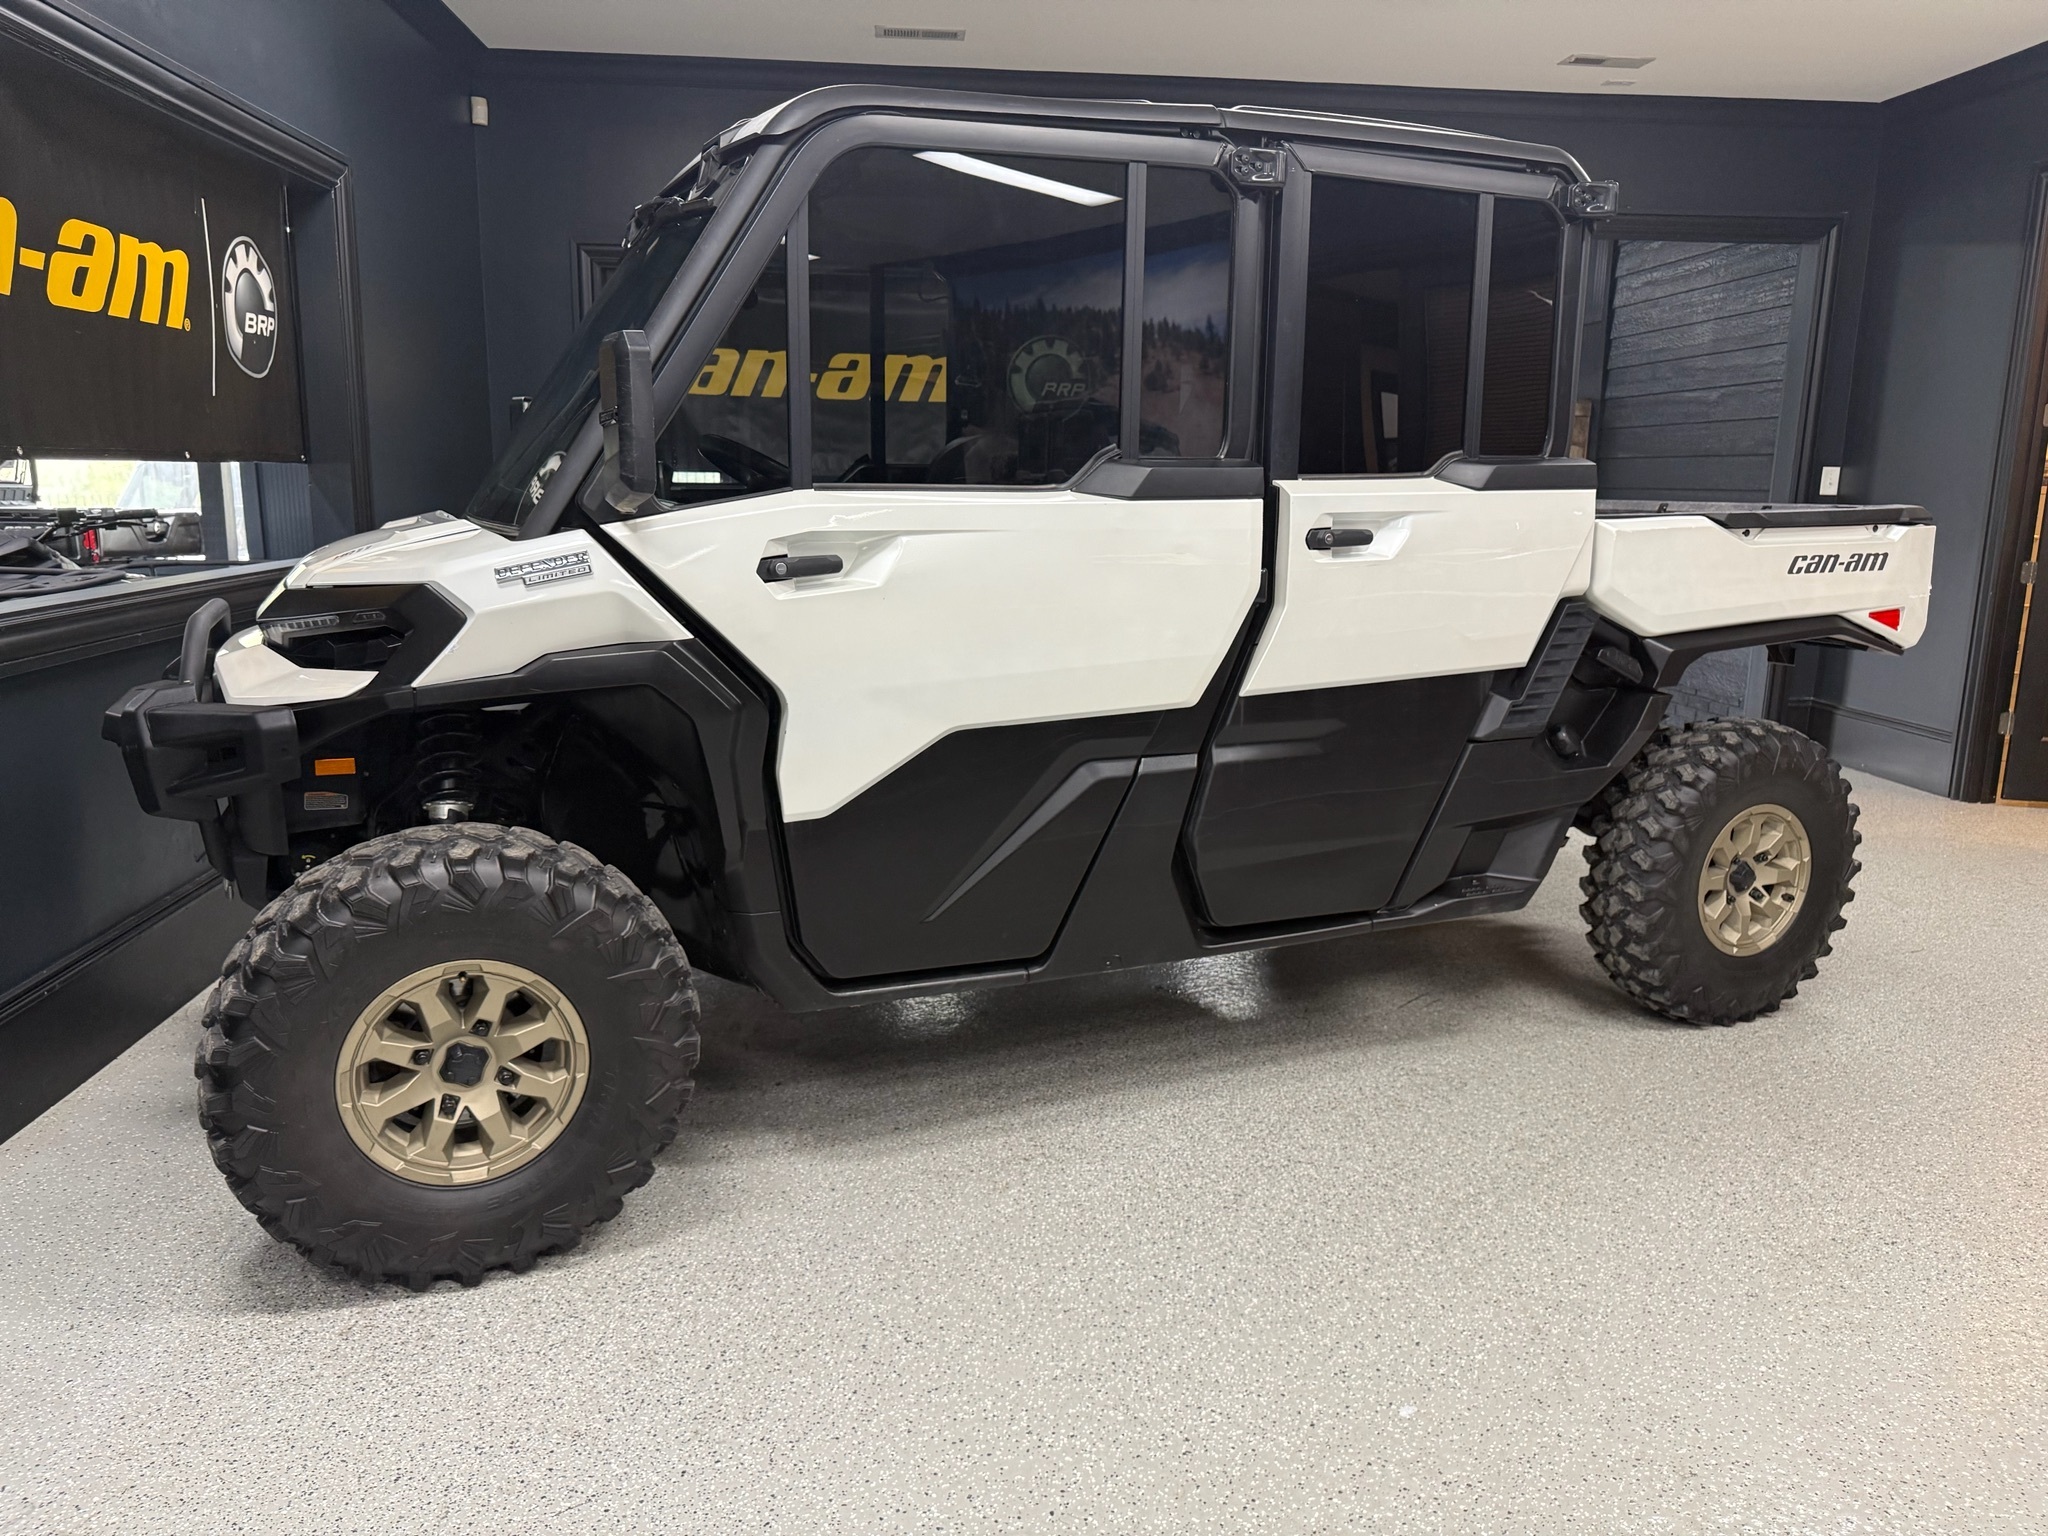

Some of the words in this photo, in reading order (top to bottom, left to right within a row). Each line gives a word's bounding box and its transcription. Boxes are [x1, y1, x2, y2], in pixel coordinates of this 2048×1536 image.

[245, 312, 275, 337] BRP
[688, 348, 947, 403] an-am
[495, 550, 591, 579] DEFENDER
[526, 566, 590, 584] LIMITED
[1787, 552, 1889, 575] can-am
